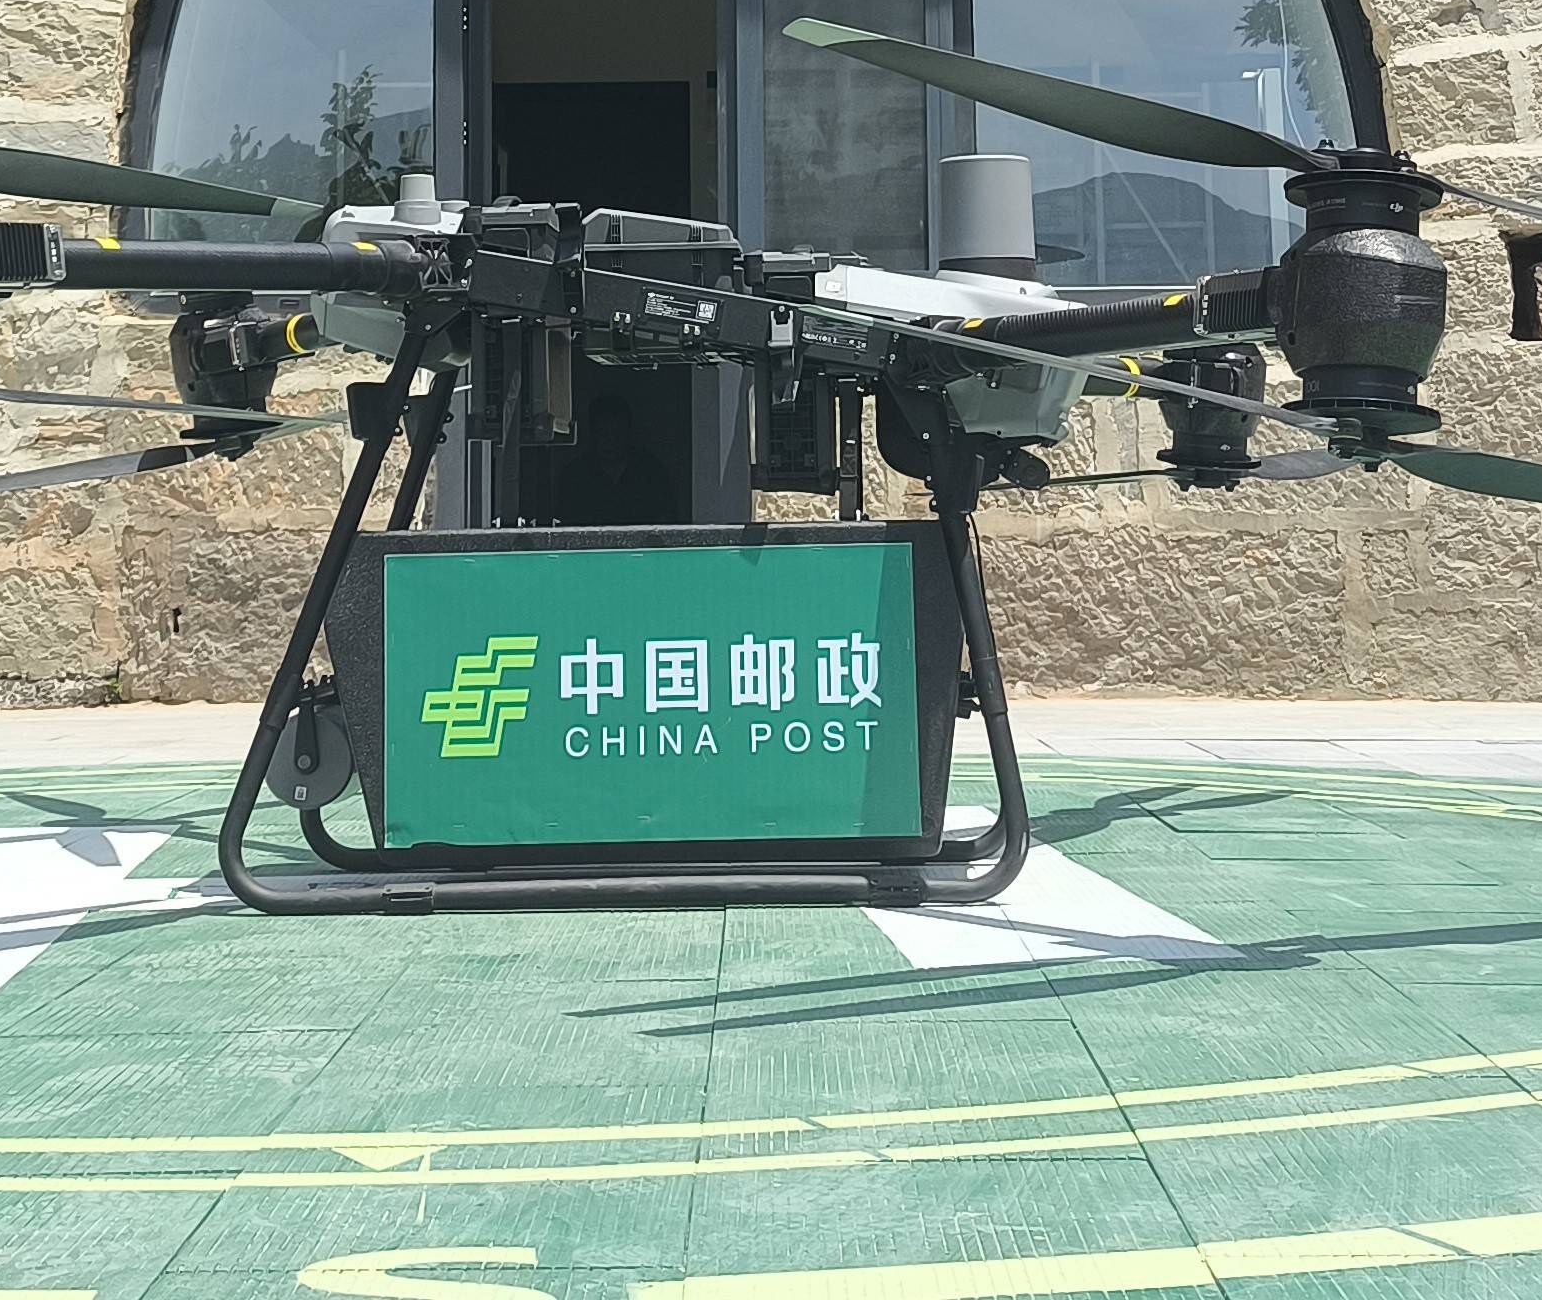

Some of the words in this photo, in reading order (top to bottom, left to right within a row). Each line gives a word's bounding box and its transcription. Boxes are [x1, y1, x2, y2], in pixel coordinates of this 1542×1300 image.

[559, 631, 883, 716] 中国邮政
[564, 723, 719, 758] CHINA
[749, 720, 880, 754] POST
